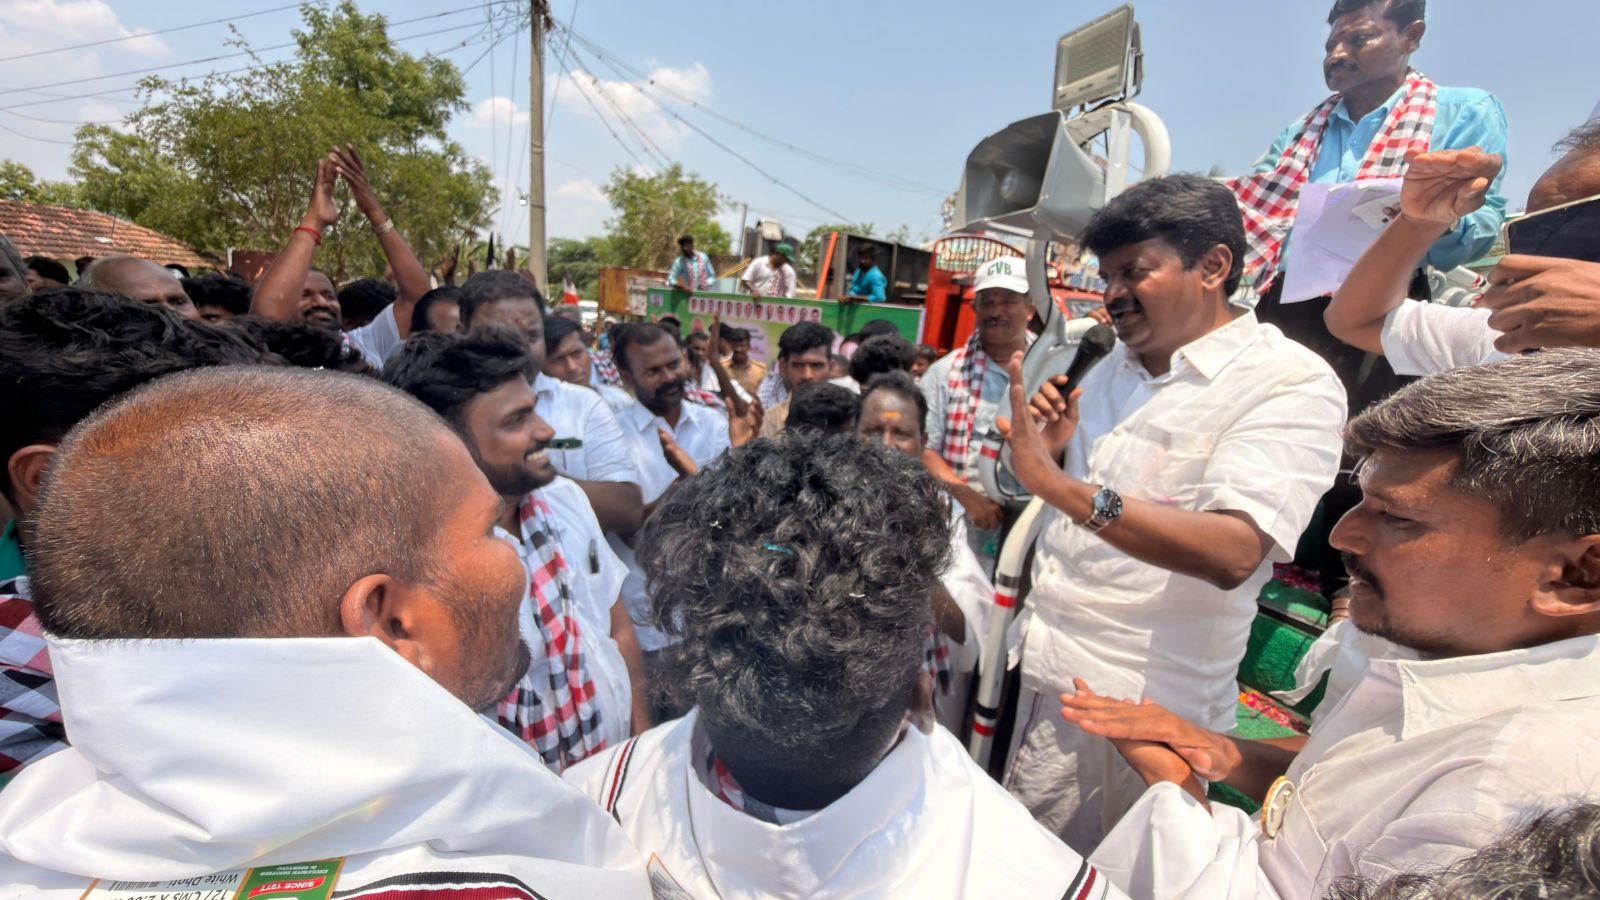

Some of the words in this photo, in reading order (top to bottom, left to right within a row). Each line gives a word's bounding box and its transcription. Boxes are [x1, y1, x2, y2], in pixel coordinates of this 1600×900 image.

[987, 260, 1012, 276] CVB
[166, 876, 203, 888] Dhoti
[205, 874, 238, 885] White
[259, 883, 283, 892] 1977
[283, 881, 315, 890] SINCE
